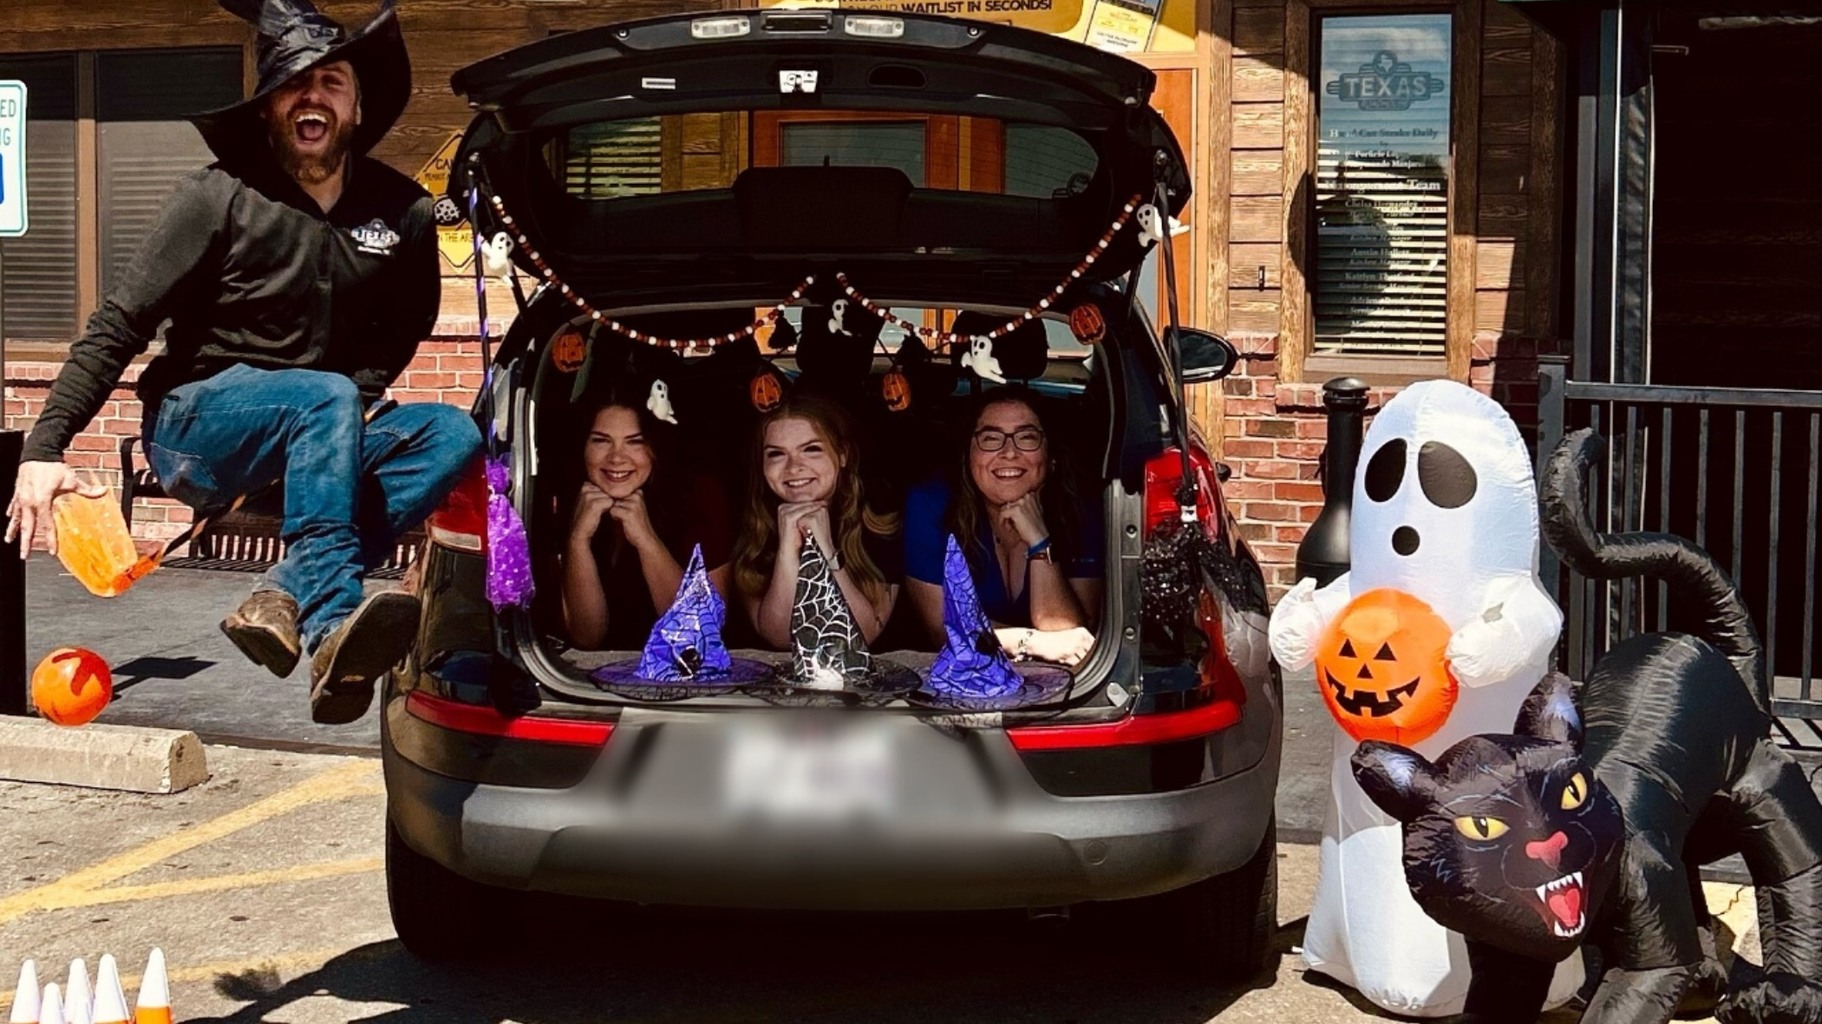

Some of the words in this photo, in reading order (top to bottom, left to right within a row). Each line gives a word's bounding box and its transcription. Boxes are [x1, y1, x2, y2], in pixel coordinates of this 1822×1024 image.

[901, 1, 963, 13] WAITLIST
[967, 1, 980, 12] IN
[1343, 76, 1427, 96] TEXAS
[1407, 179, 1441, 190] Team
